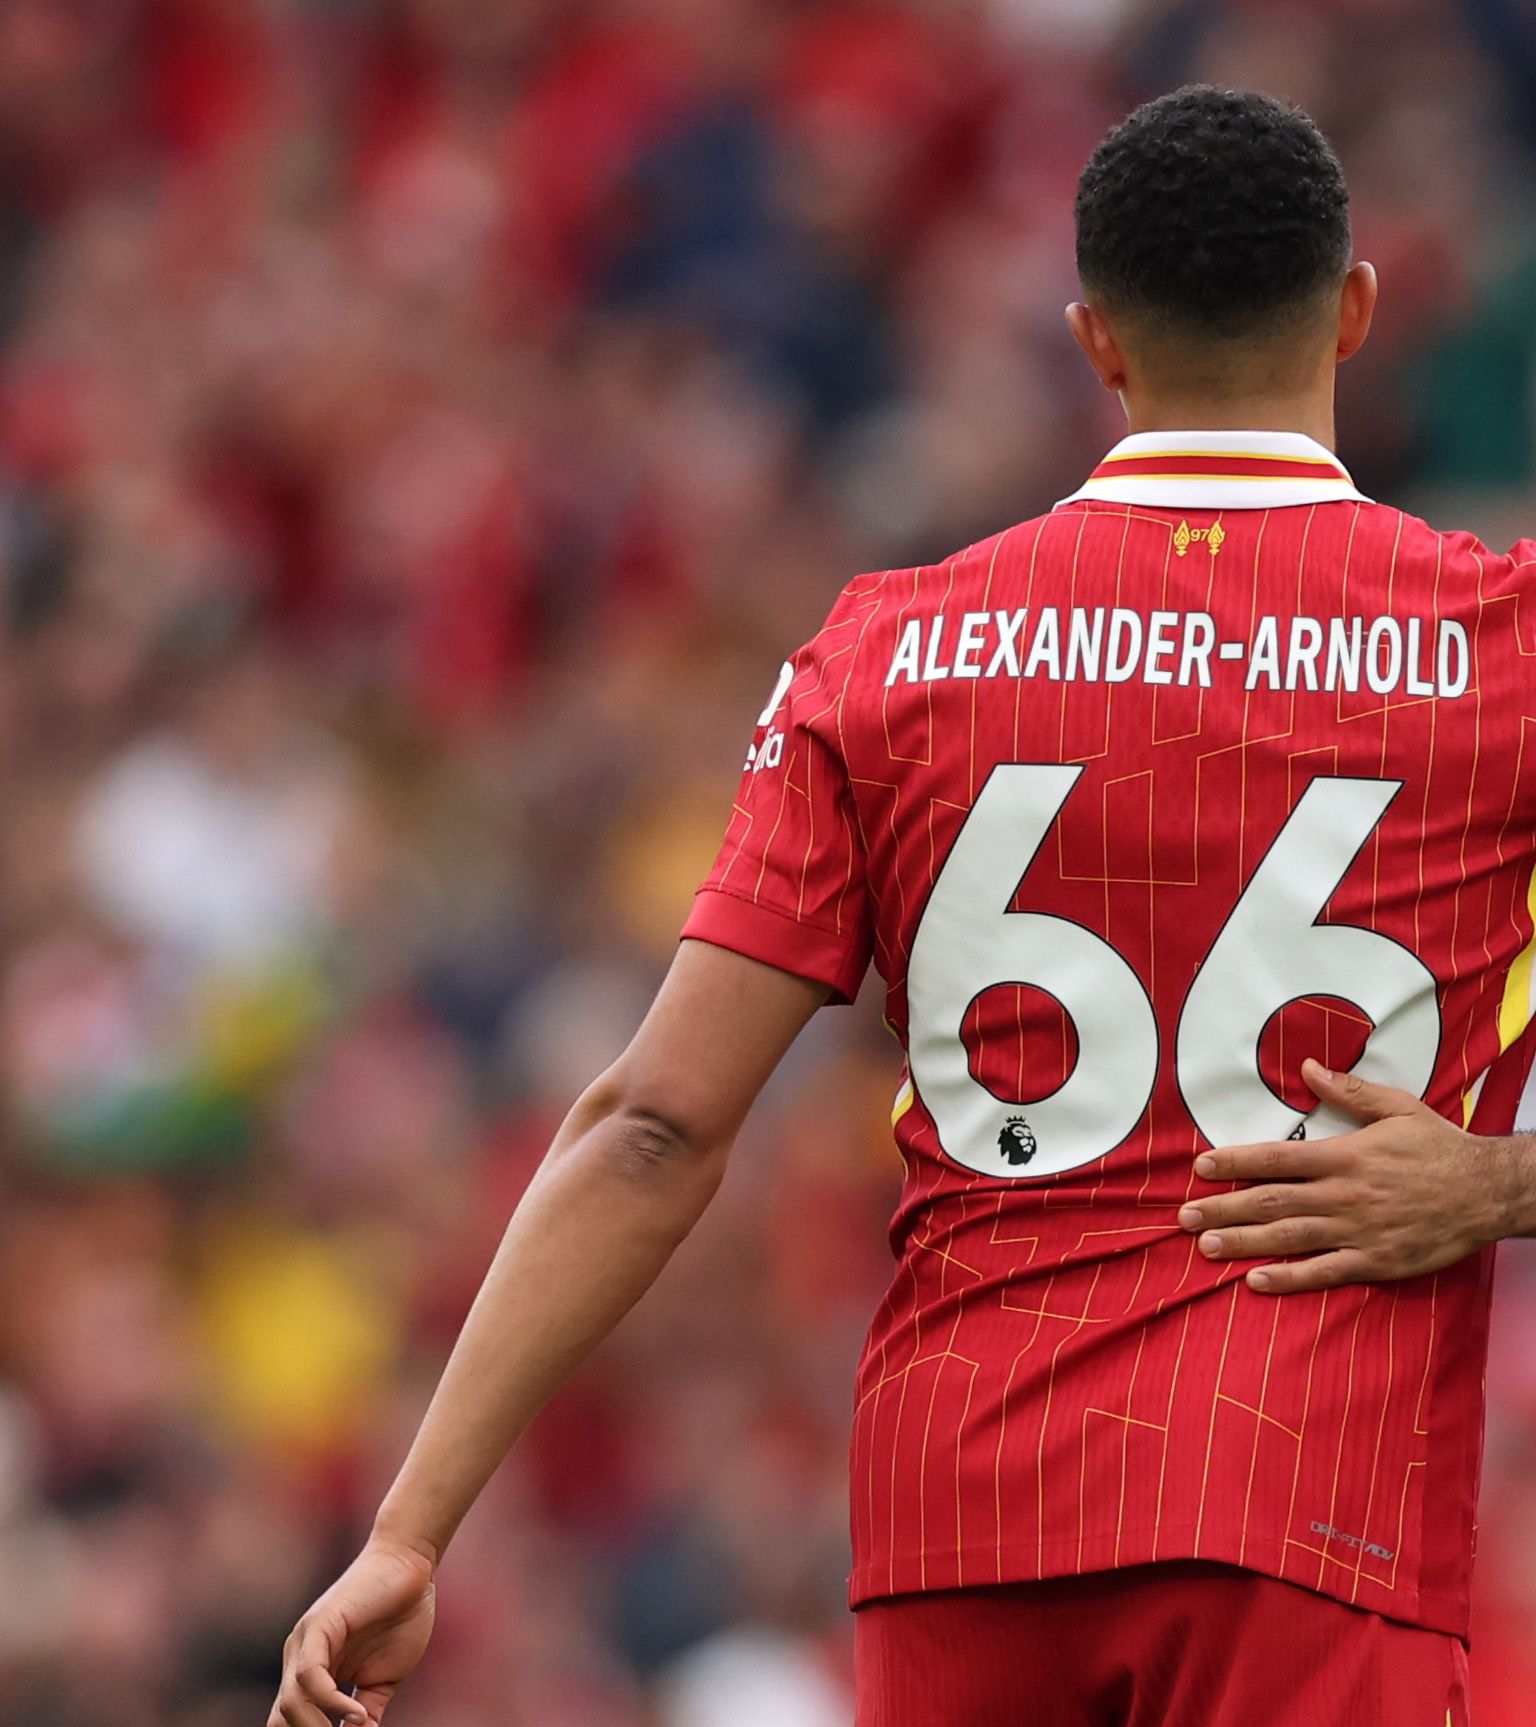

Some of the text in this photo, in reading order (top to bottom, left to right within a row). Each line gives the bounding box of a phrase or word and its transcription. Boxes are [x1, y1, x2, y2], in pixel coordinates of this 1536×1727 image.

[1190, 528, 1210, 542] 97
[884, 607, 1469, 699] ALEXANDER-ARNOLD
[906, 762, 1441, 1178] 66
